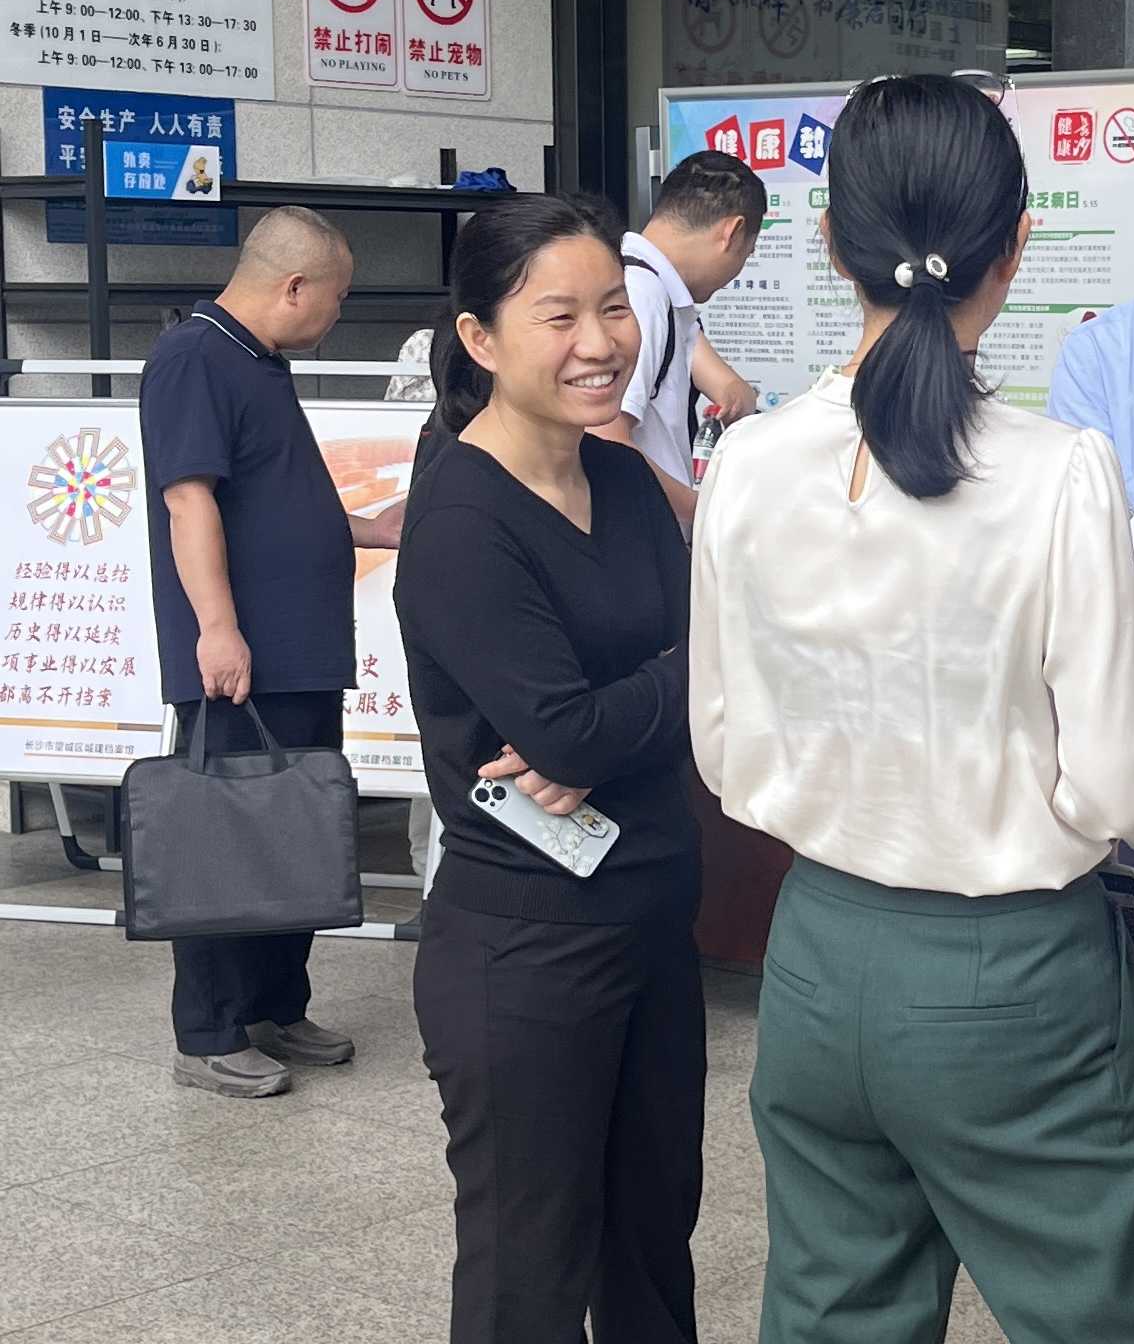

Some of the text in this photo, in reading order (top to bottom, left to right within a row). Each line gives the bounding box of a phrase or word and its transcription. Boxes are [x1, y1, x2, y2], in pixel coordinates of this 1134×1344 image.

[314, 26, 392, 57] 禁止打闹
[409, 38, 482, 67] 禁止宠物
[321, 58, 386, 72] NO PLAYING
[424, 69, 439, 79] NO
[58, 105, 223, 138] 安全生产 人人有责
[16, 560, 130, 583] 经验得以总结
[8, 591, 127, 613] 规律得以认识
[5, 622, 122, 646] 历史得以延续
[1, 652, 136, 677] 项事业得以发展
[0, 683, 112, 708] 都离不开档案
[25, 738, 135, 755] 长沙市望城区城建档案馆
